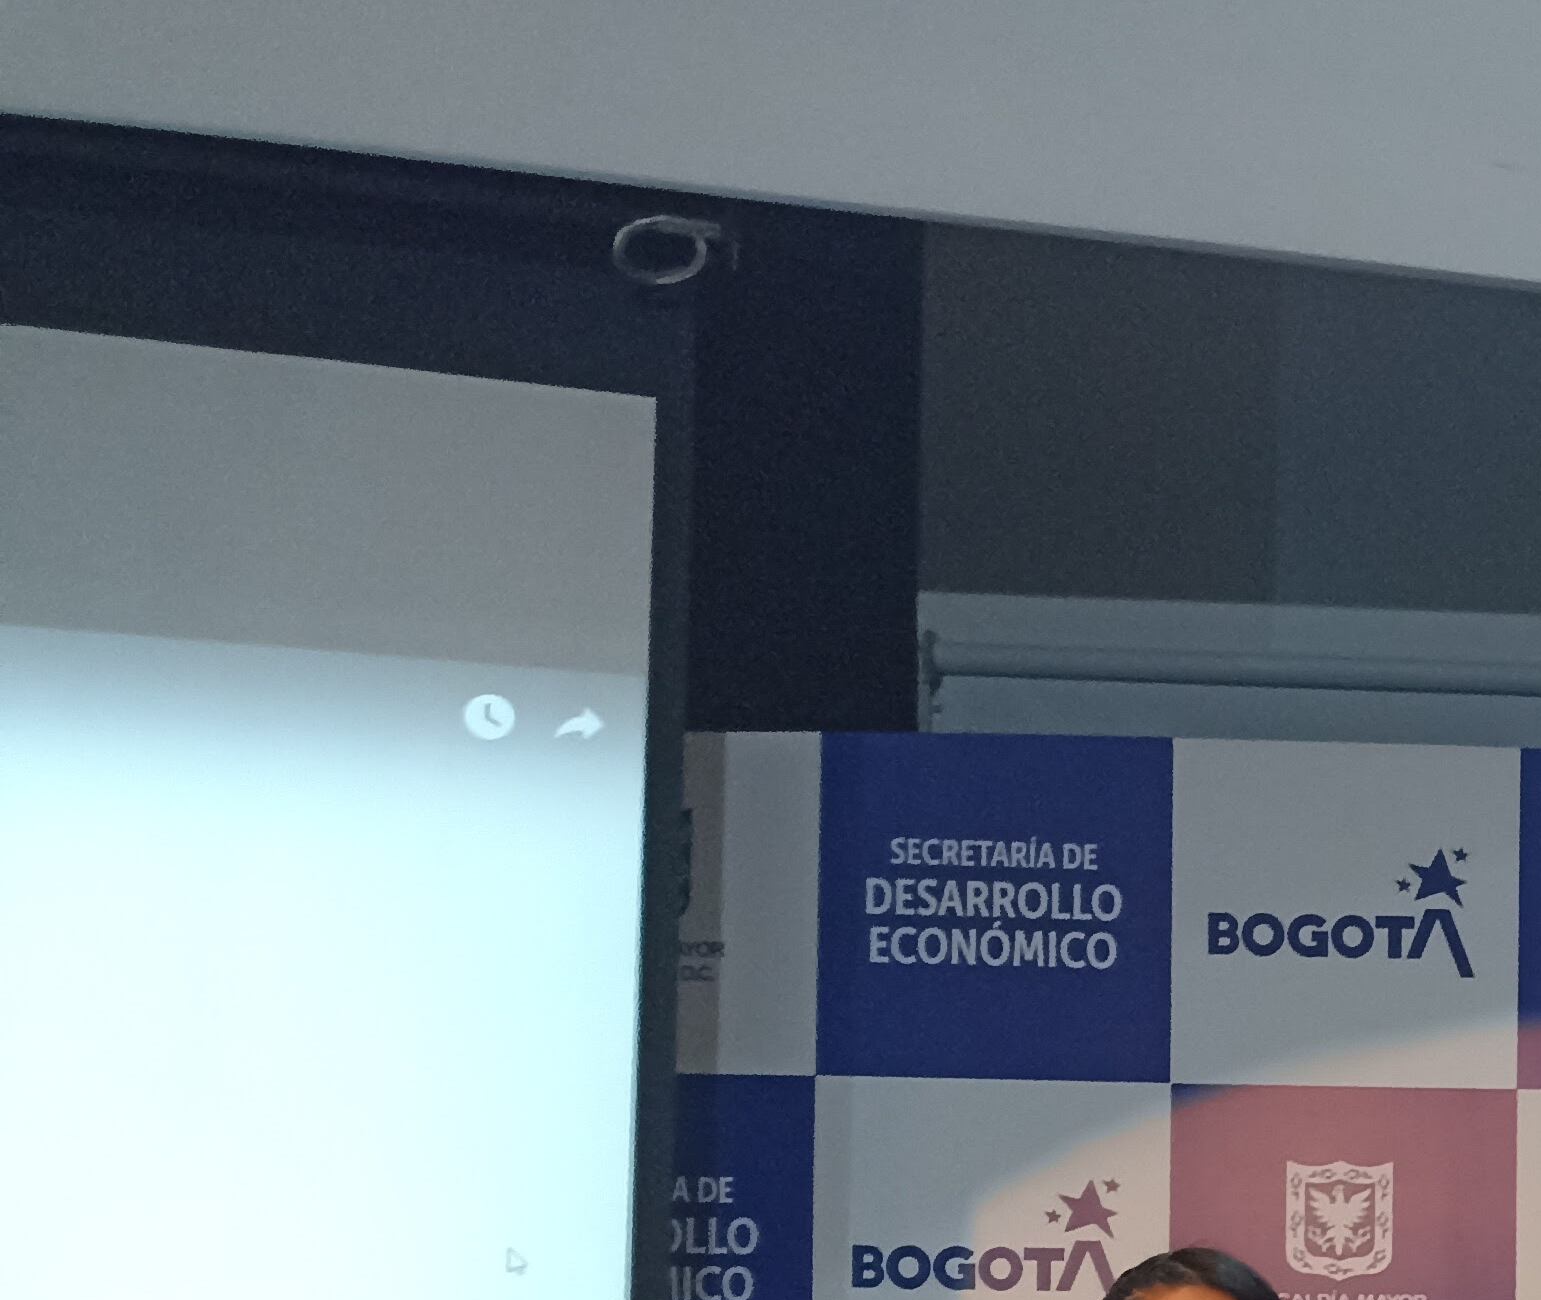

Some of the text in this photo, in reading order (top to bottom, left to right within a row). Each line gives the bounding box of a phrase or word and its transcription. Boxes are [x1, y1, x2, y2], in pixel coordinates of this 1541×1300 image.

[891, 836, 1098, 871] SECRETARÍA DE
[866, 877, 1122, 922] DESARROLLO
[870, 922, 1118, 970] ECONÓMICO
[699, 1176, 735, 1204] DE
